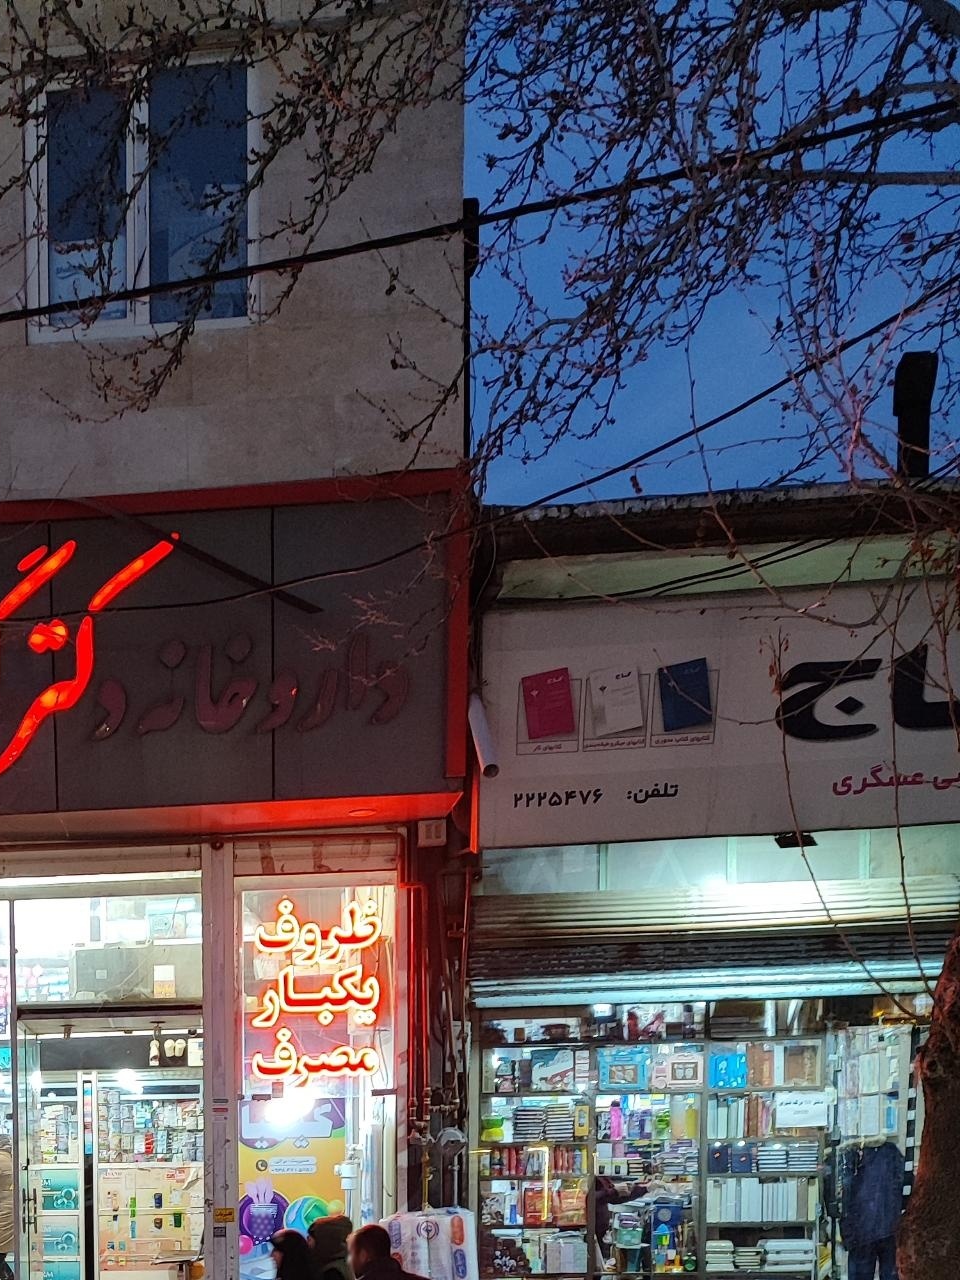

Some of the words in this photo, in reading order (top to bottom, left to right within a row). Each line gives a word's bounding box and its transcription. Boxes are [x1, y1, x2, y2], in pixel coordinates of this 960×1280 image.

[775, 643, 960, 743] اج
[513, 788, 604, 808] ۲۲۲۵۴۷۶
[626, 783, 679, 804] تلفن:
[832, 764, 924, 796] عسگری
[254, 898, 383, 966] ظروف
[250, 964, 381, 1028] یکبار
[252, 1027, 381, 1087] مصرف
